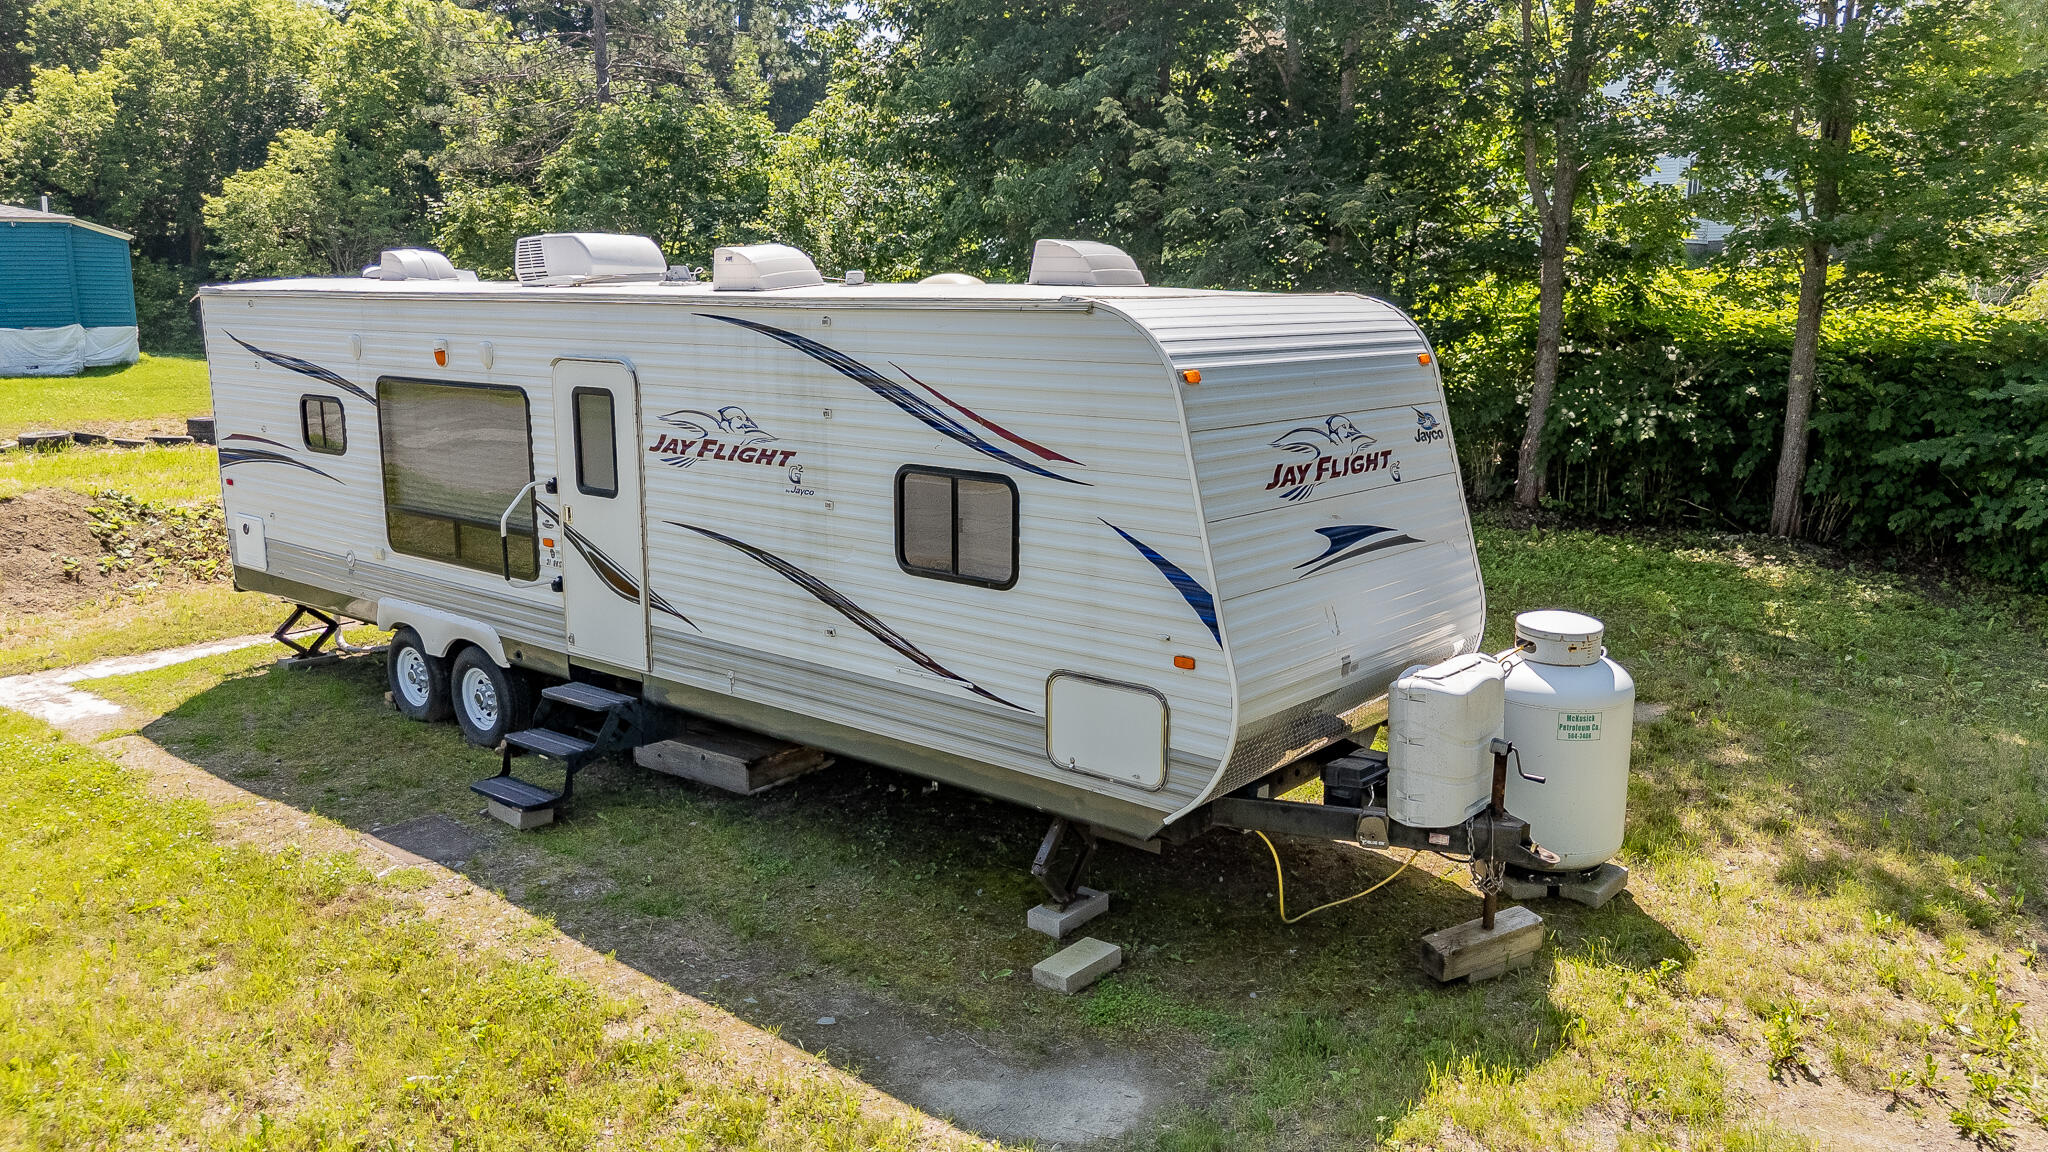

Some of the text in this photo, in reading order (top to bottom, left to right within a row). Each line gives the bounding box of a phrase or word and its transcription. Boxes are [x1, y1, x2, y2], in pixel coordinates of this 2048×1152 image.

[1414, 428, 1444, 445] Jayco
[649, 434, 797, 467] JAY FLIGHT
[1265, 450, 1392, 490] JAY FLIGHT
[791, 485, 815, 496] Jayco
[1559, 723, 1591, 731] Petroleum
